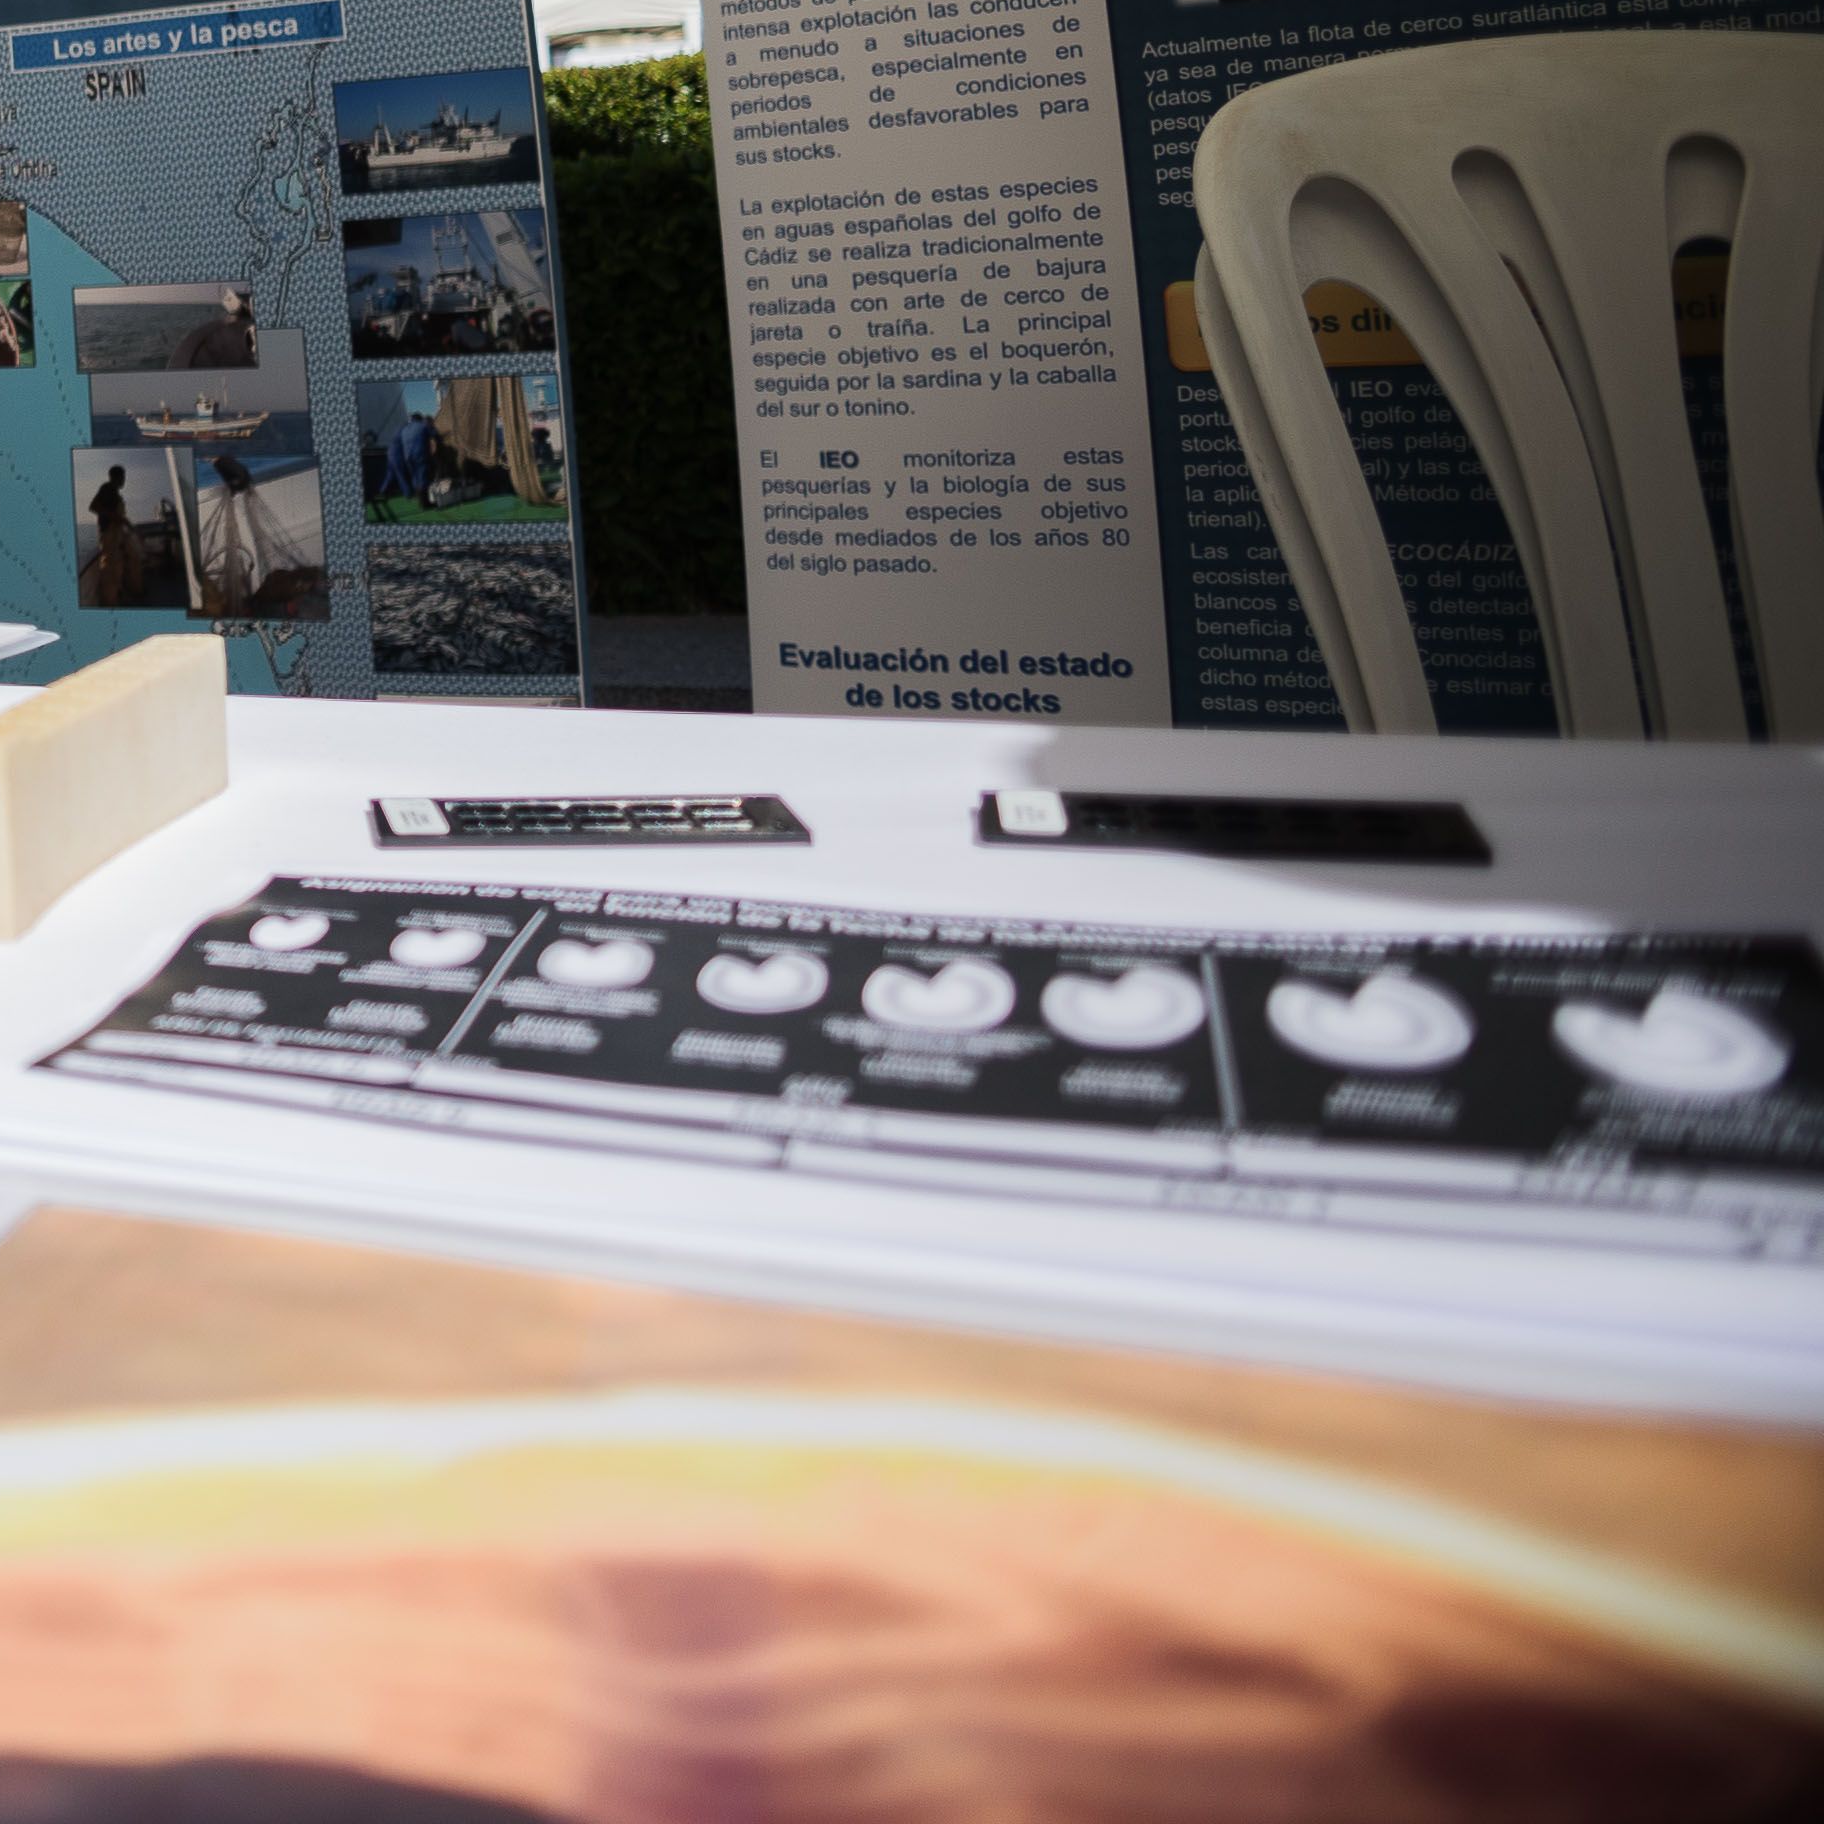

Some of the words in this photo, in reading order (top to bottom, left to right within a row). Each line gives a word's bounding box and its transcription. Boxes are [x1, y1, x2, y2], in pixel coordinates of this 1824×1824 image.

[53, 39, 97, 60] Los
[103, 32, 161, 55] artes
[167, 29, 183, 53] y
[190, 22, 213, 45] la
[220, 18, 299, 47] pesca
[85, 67, 146, 101] SPAIN
[759, 449, 778, 469] El
[819, 450, 860, 469] IEO
[903, 448, 1016, 468] monitoriza
[1063, 447, 1124, 466] estas
[761, 475, 871, 498] pesquerías
[884, 480, 897, 499] y
[909, 476, 929, 495] la
[943, 474, 1030, 498] biología
[1043, 473, 1072, 493] de
[1086, 477, 1126, 492] sus
[763, 502, 869, 524] principales
[905, 502, 1003, 525] especies
[1040, 501, 1128, 524] objetivo
[765, 527, 824, 546] desde
[835, 528, 938, 547] mediados
[949, 528, 978, 547] de
[989, 528, 1022, 547] los
[1034, 528, 1090, 547] años
[1102, 527, 1130, 547] 80
[766, 552, 795, 571] del
[800, 553, 847, 577] siglo
[853, 555, 938, 577] pasado.
[779, 642, 950, 674] Evaluación
[959, 648, 1009, 675] del
[1018, 651, 1134, 679] estado
[845, 682, 884, 708] de
[893, 684, 942, 710] los
[951, 687, 1062, 714] stocks
